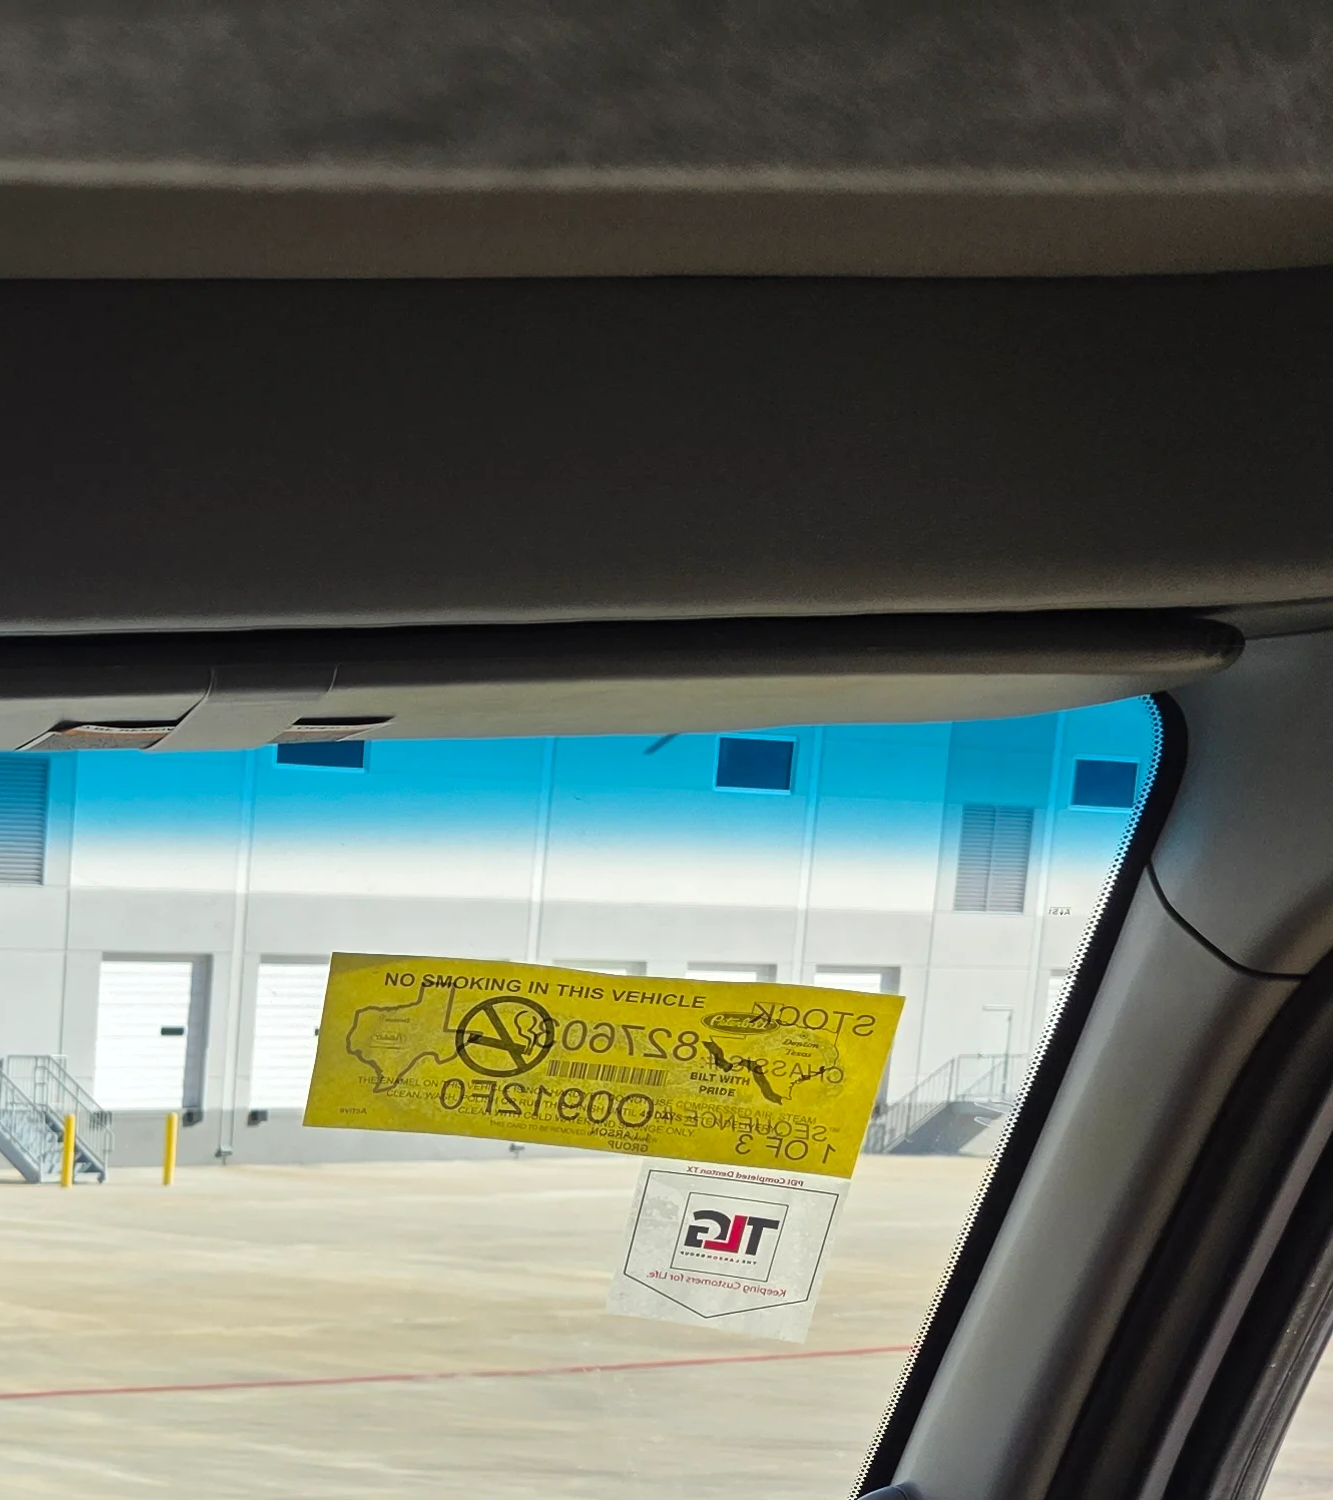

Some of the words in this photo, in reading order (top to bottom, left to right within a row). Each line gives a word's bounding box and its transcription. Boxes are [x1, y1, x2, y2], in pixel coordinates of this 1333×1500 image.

[384, 972, 415, 987] NO
[421, 974, 521, 993] SMOKING
[528, 981, 548, 995] IN
[557, 984, 604, 1000] THIS
[612, 989, 707, 1009] VEHICLE
[782, 1038, 820, 1049] Denton
[785, 1049, 813, 1058] Texas
[690, 1071, 716, 1082] BILT
[719, 1074, 750, 1086] WITH
[699, 1085, 736, 1097] PRIDE
[358, 1076, 376, 1085] THE
[423, 1079, 438, 1087] ON
[676, 1101, 752, 1117] COMPRESSED
[777, 1112, 817, 1124] STEAM
[655, 1111, 683, 1122] DAYS
[507, 1121, 526, 1130] CARD
